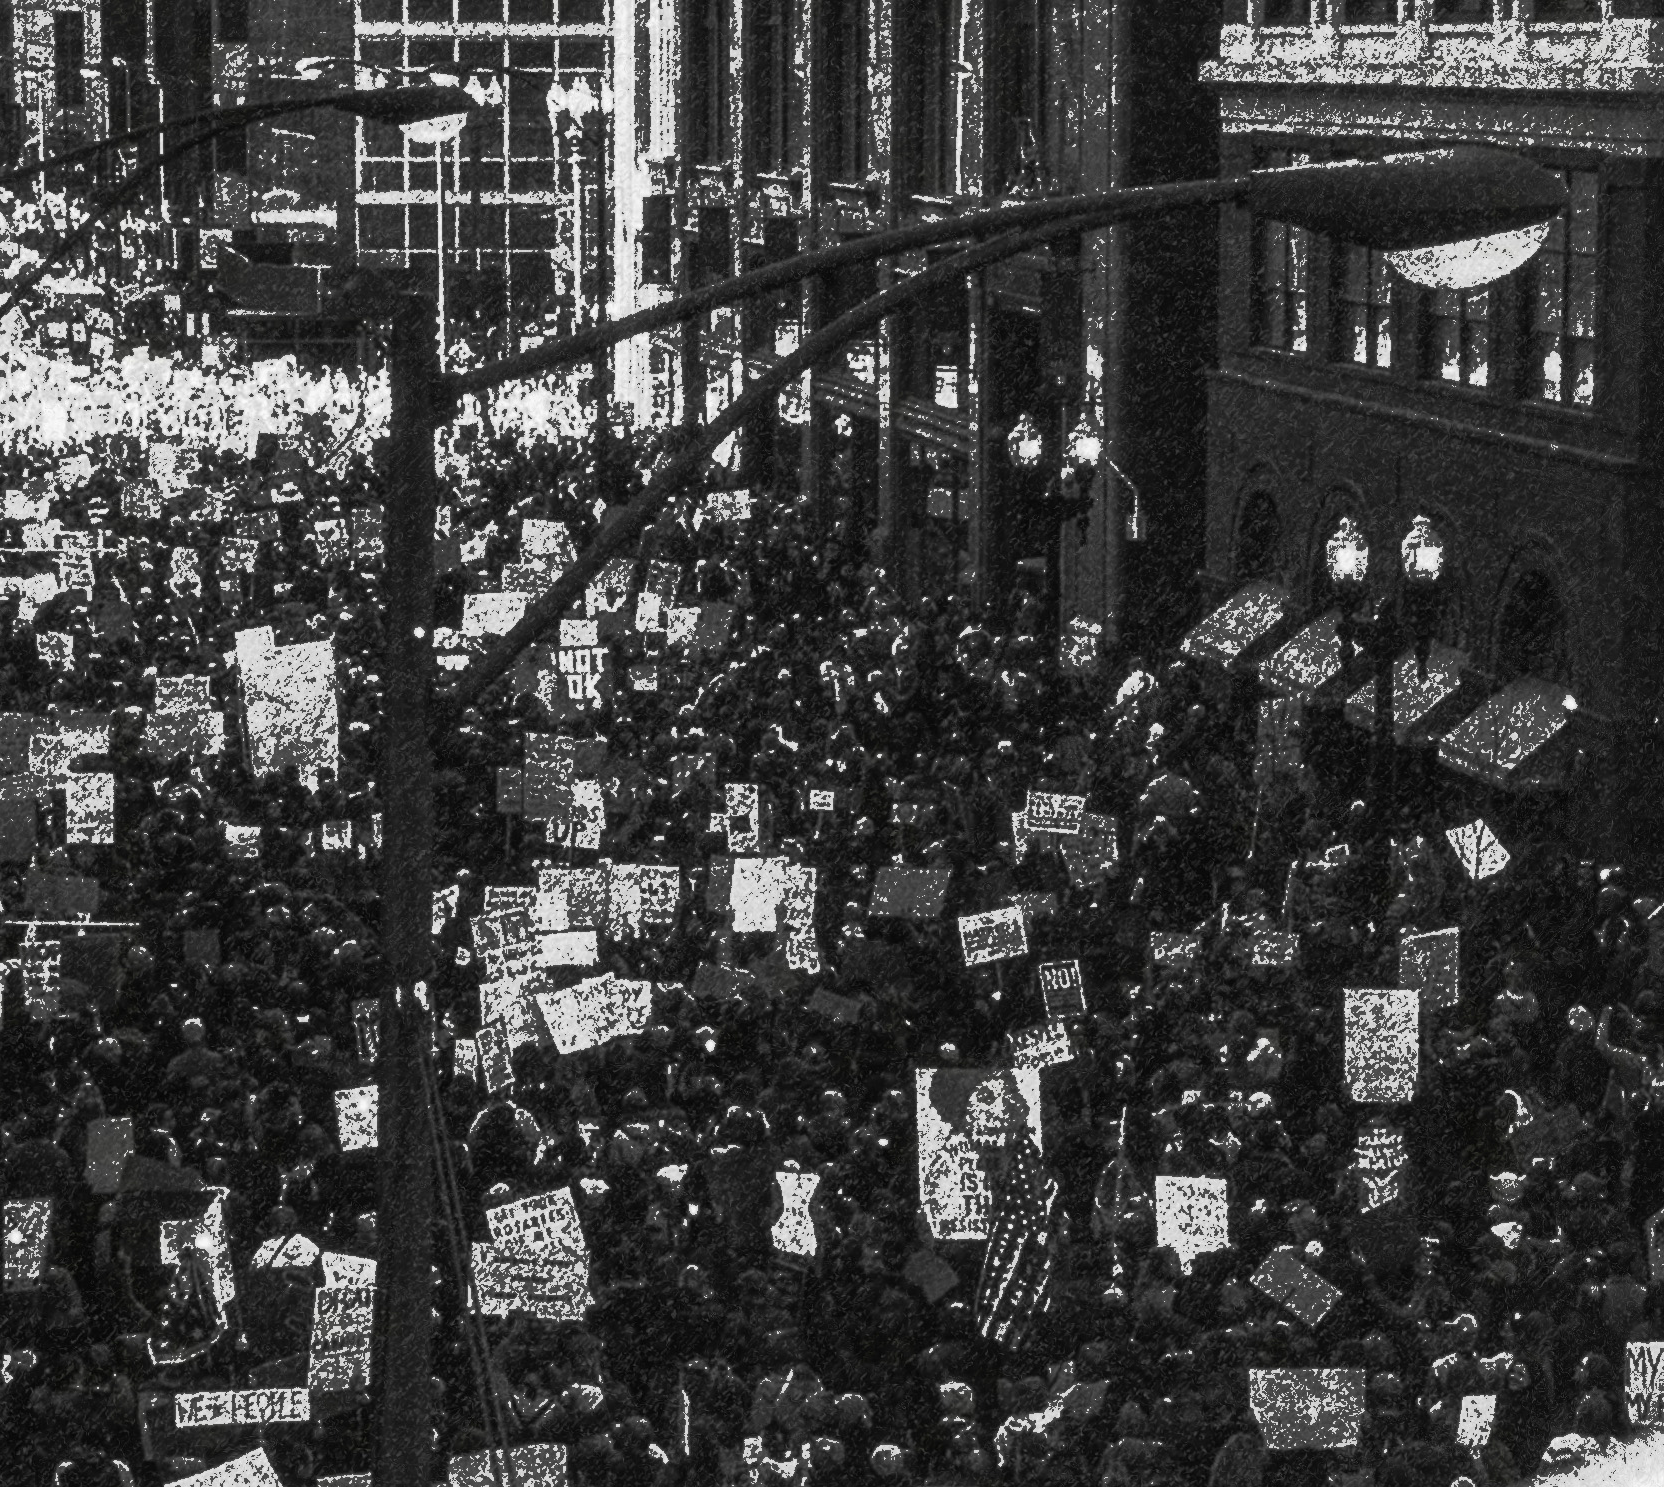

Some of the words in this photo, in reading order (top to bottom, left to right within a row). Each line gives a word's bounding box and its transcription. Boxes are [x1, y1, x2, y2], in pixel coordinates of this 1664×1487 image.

[558, 647, 609, 674] NOT
[566, 673, 603, 708] OK
[1043, 966, 1078, 990] NO!
[492, 1207, 566, 1238] ROSARIES
[1626, 1346, 1664, 1391] MY
